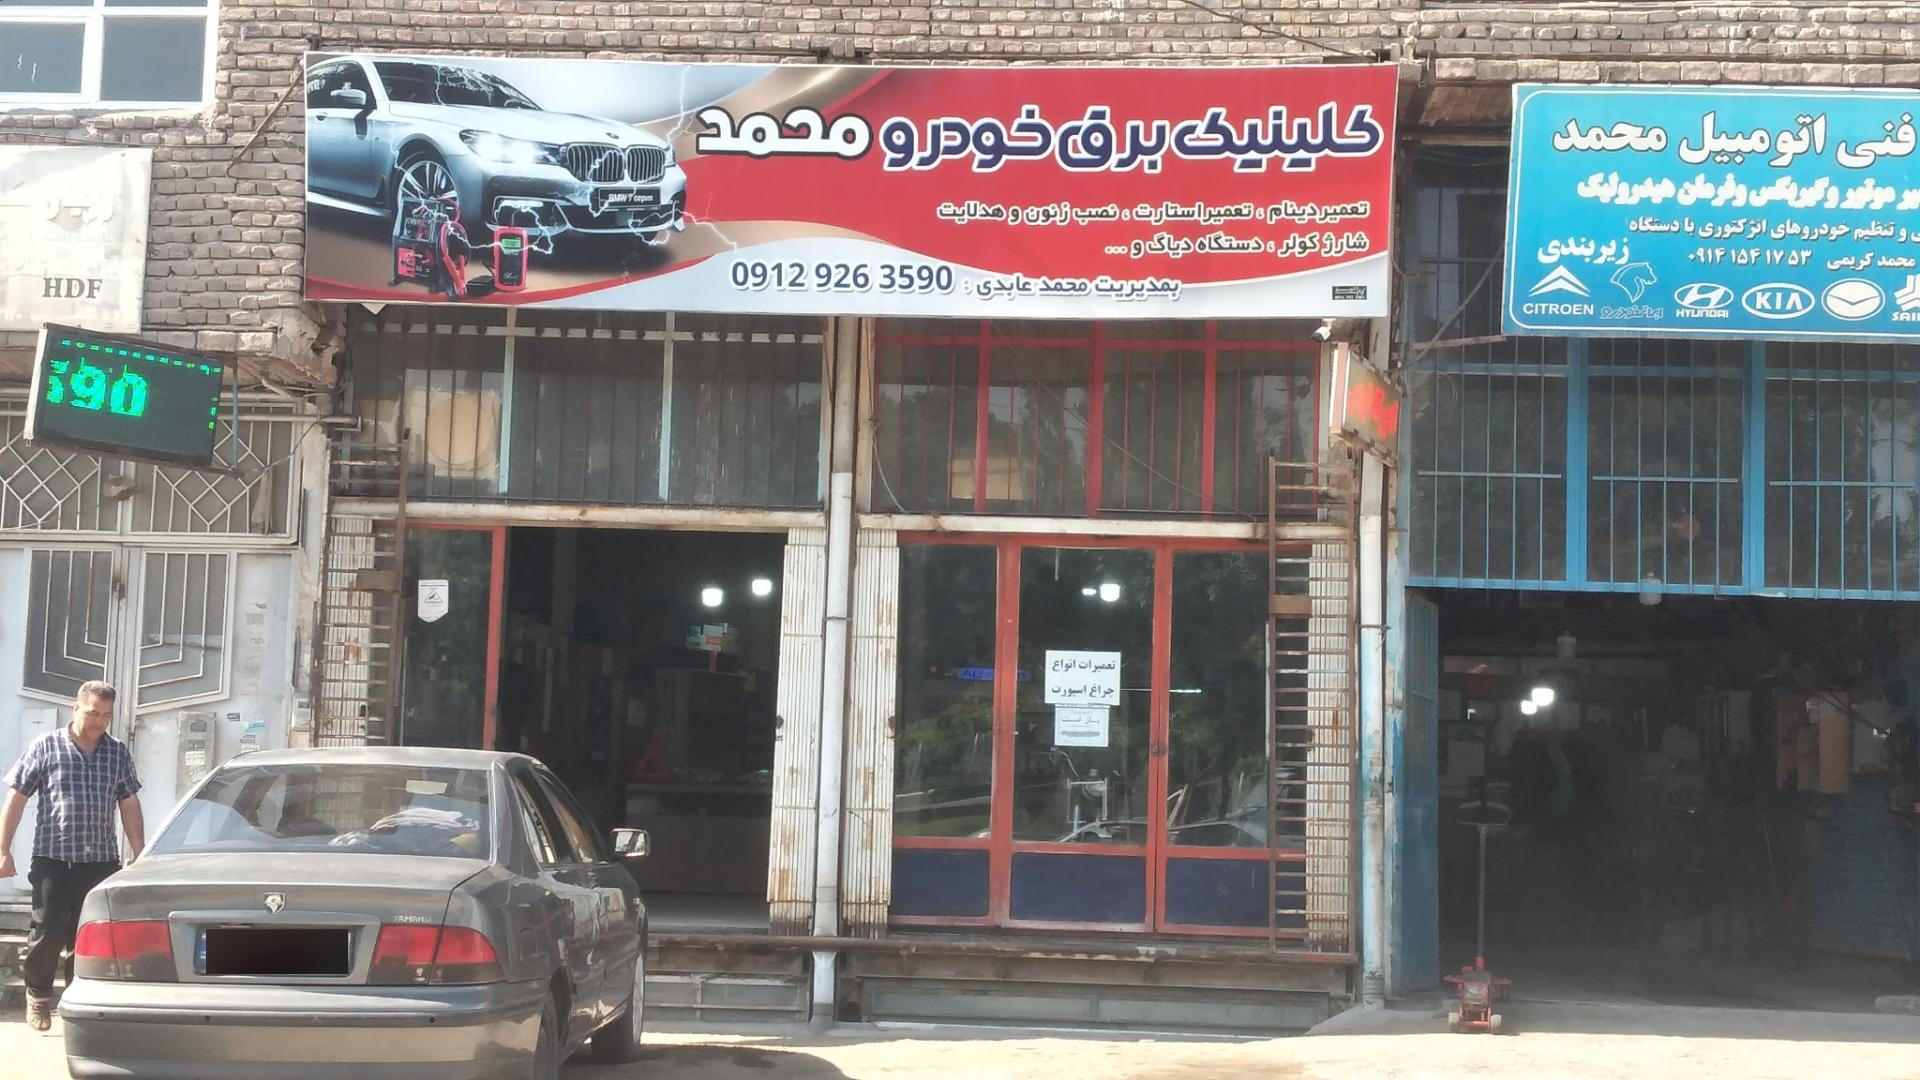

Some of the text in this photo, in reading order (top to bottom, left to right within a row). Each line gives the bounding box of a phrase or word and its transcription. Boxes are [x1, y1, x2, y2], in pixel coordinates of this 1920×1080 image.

[696, 102, 1382, 173] کلینیک برق خودرو محمد
[1552, 110, 1916, 169] فنی اتومبیل محمد
[937, 201, 1004, 224] هدلایت
[1008, 205, 1021, 224] و
[1025, 202, 1070, 223] زنون
[1074, 204, 1117, 224] نصب
[1629, 216, 1680, 233] دستگاه
[1684, 217, 1695, 236] با
[1771, 218, 1850, 240] خودروهای
[1854, 220, 1896, 240] تنظیم
[1130, 239, 1143, 257] و
[1148, 232, 1192, 257] دیاگ
[1197, 231, 1263, 253] دستگاه
[1278, 234, 1320, 257] کولر
[1322, 233, 1369, 256] شارژ
[1537, 237, 1629, 265] زیربندی
[1827, 252, 1916, 270] محمد کریمی
[731, 261, 805, 288] 0912
[814, 263, 870, 289] 926
[879, 264, 953, 291] 3590
[1038, 277, 1090, 294] محمد
[42, 277, 103, 299] HDF
[976, 274, 1033, 298] عابدی
[1095, 276, 1181, 299] بمدیریت
[1523, 303, 1594, 315] CITROEN
[1755, 292, 1803, 310] KIA
[1676, 309, 1729, 318] HYUNDAI
[1052, 659, 1115, 672] تعمیرات انواع
[1051, 684, 1115, 698] چراغ اسپورت
